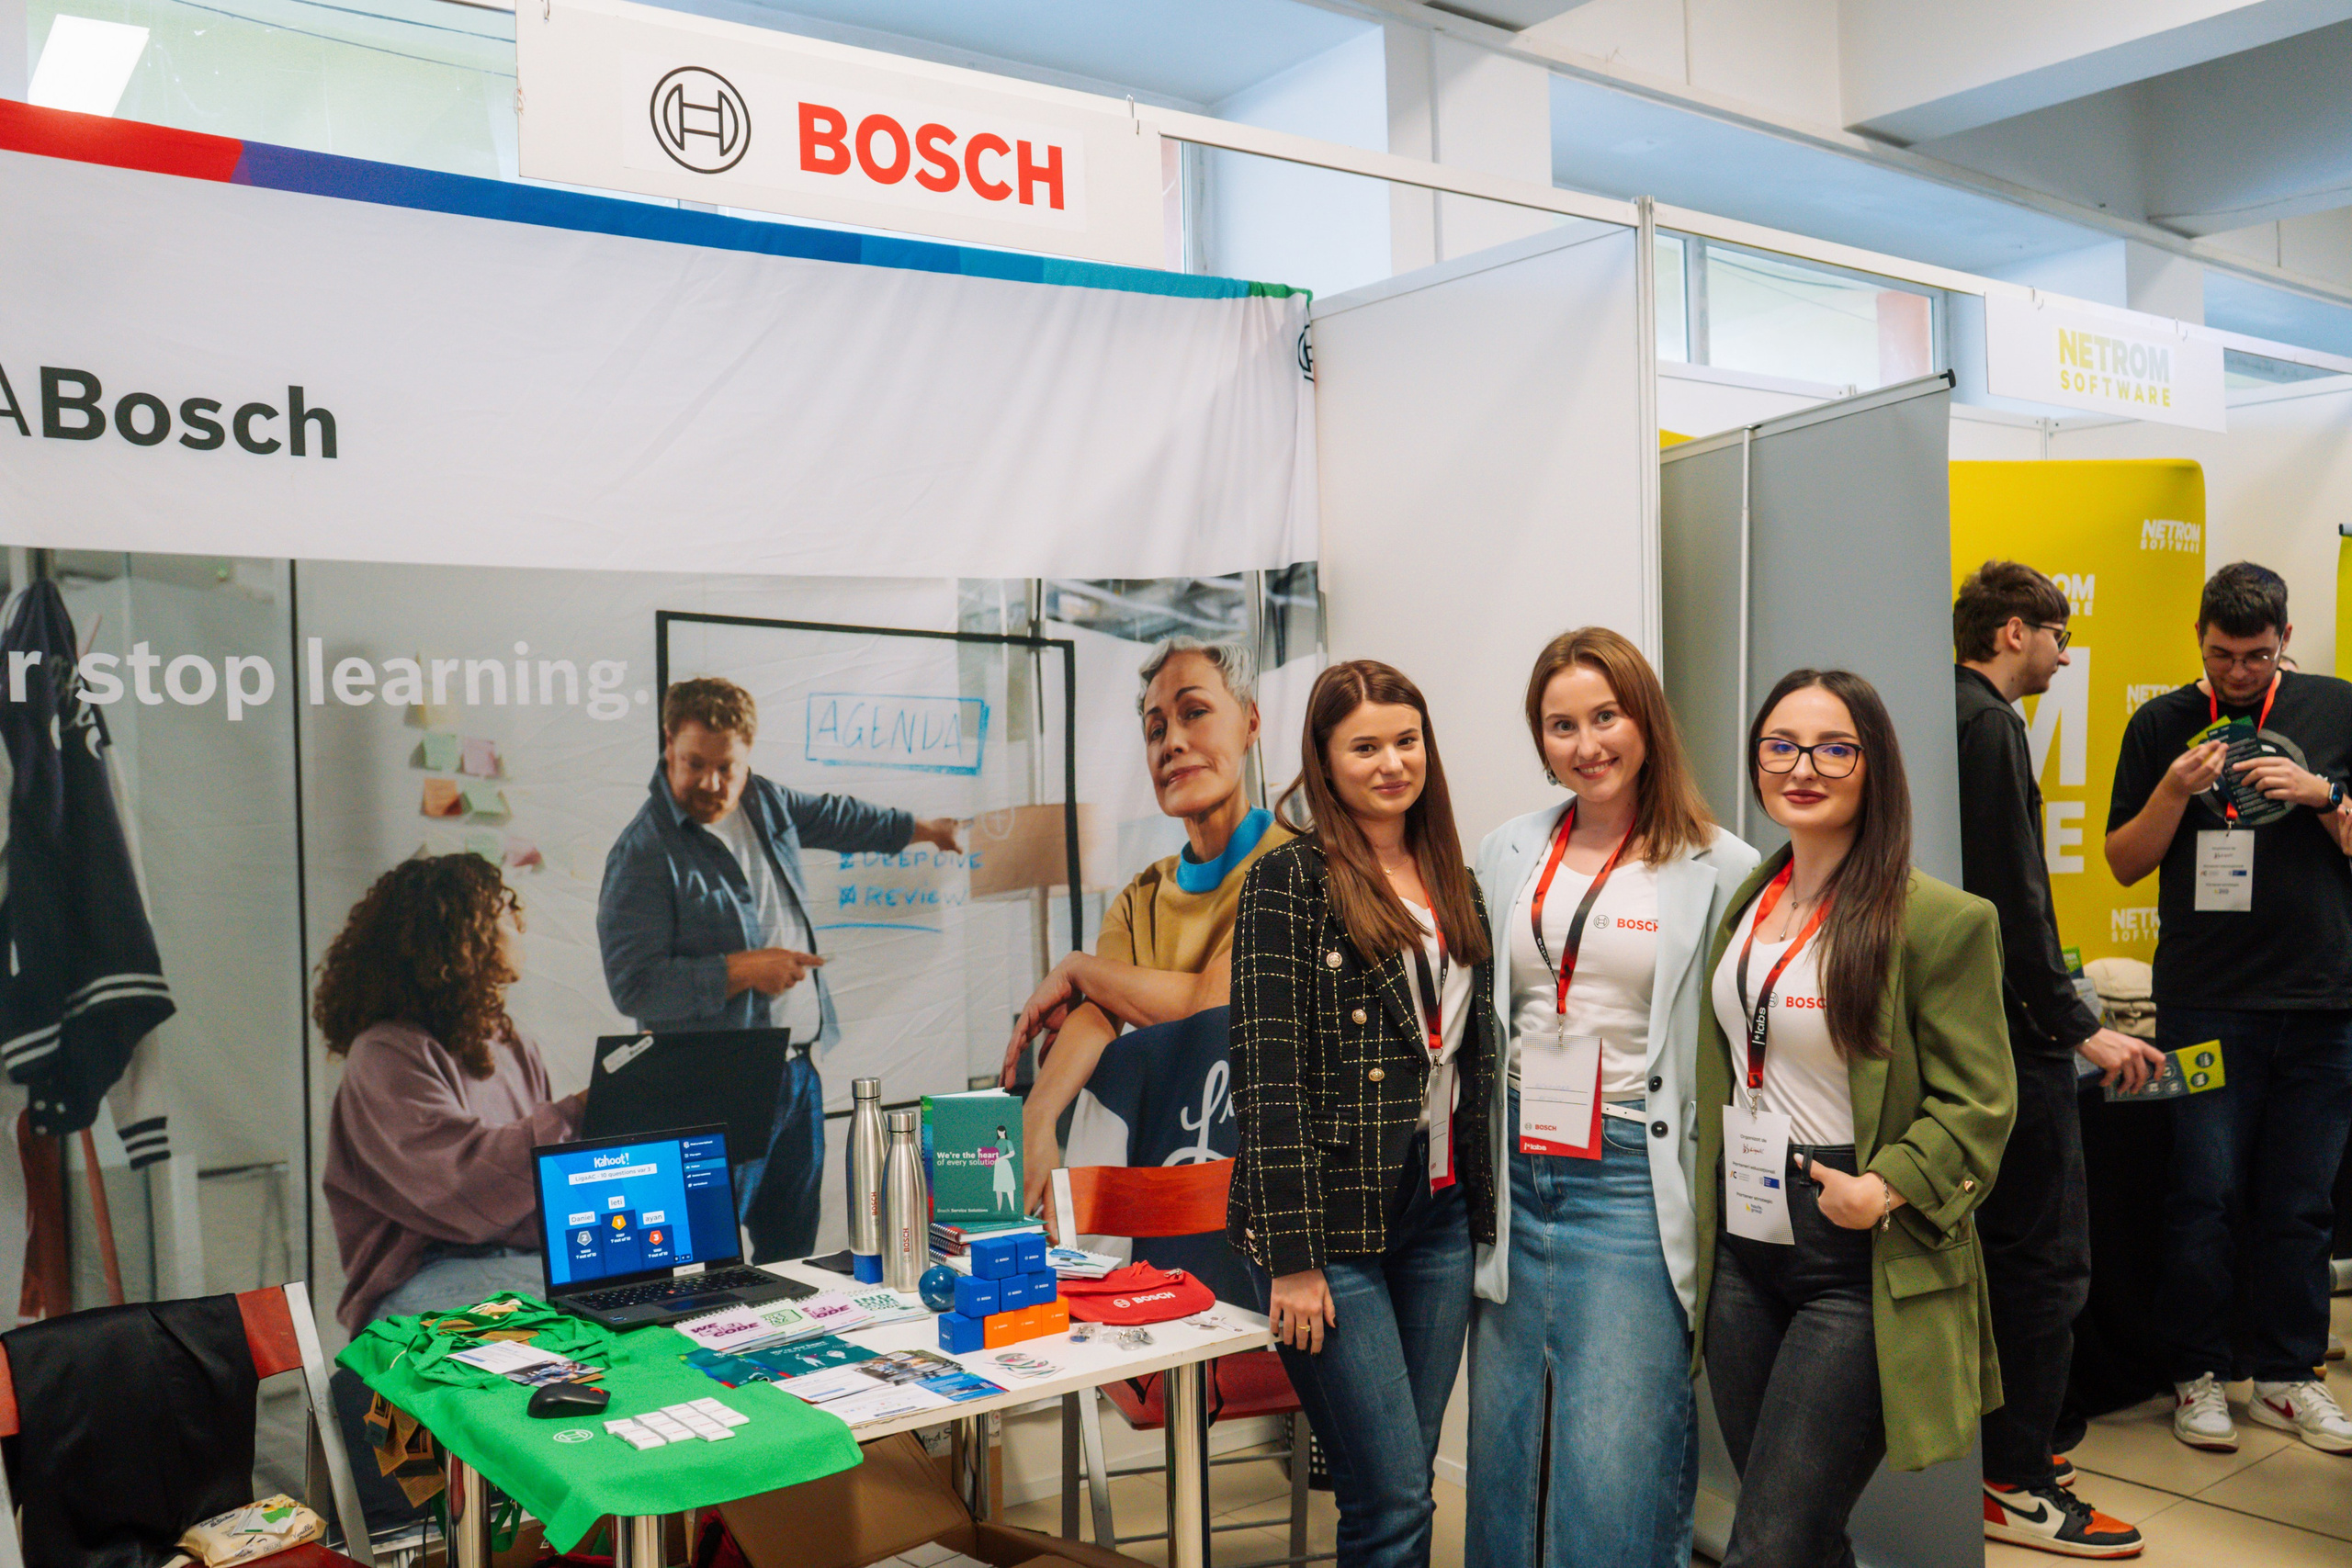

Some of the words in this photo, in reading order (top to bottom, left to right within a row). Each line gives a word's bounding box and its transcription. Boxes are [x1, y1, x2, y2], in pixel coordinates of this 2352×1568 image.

[798, 101, 1065, 211] BOSCH
[2058, 327, 2170, 384] NETROM
[2060, 369, 2171, 408] SOFTWARE
[2141, 519, 2200, 544] NETROM
[2140, 538, 2199, 555] SOFTWARE
[74, 640, 276, 722] stop
[306, 637, 650, 721] learning.
[817, 699, 964, 759] AGENDA
[1534, 1123, 1557, 1132] BOSCH
[594, 1152, 630, 1168] Kahoot!
[607, 1168, 637, 1179] questions
[870, 1191, 878, 1216] BOSCH
[571, 1213, 594, 1223] Daniel
[645, 1214, 663, 1223] ayan
[653, 1234, 660, 1242] 3
[1132, 1292, 1176, 1304] BOSCH
[689, 1322, 719, 1334] WE
[713, 1322, 761, 1337] CODE
